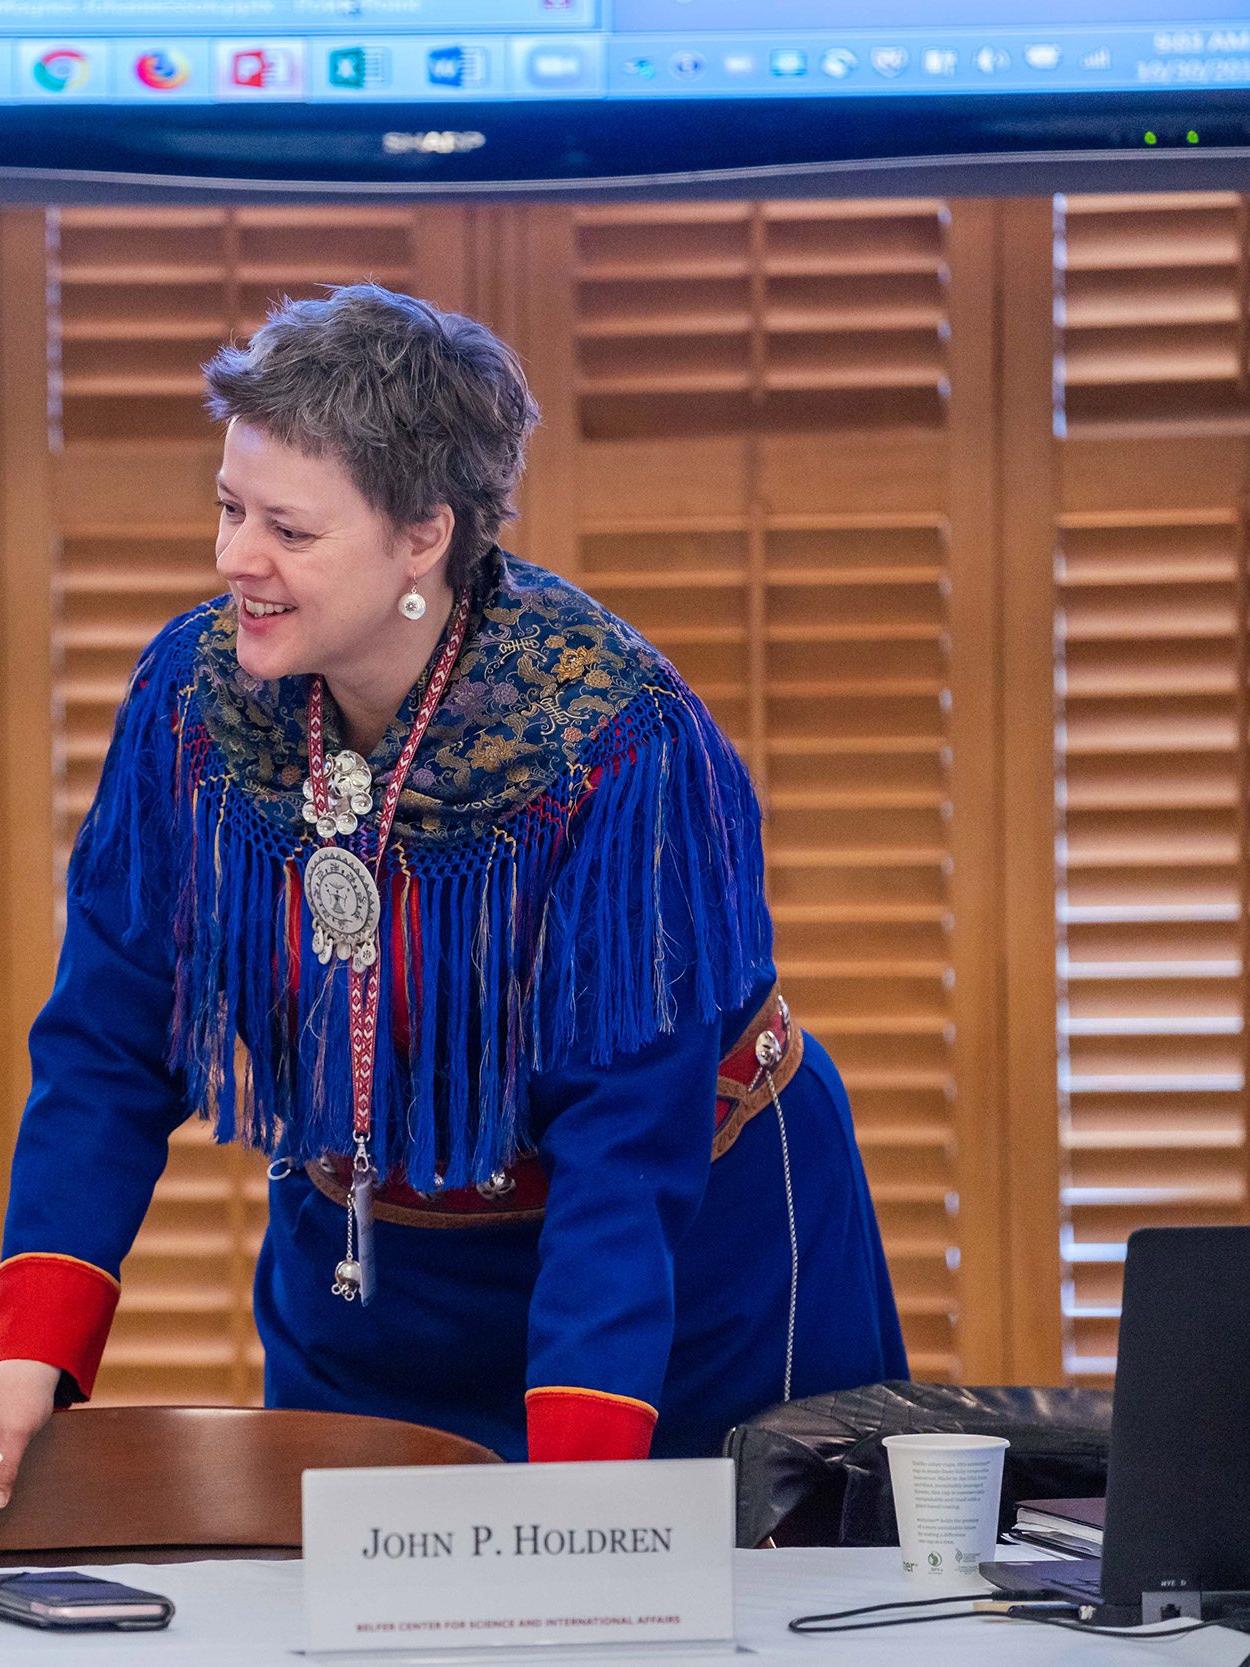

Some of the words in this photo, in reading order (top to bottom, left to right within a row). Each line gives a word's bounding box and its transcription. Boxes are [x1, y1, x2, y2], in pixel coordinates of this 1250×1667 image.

[473, 1526, 501, 1556] P.
[514, 1525, 672, 1555] HOLDREN
[399, 1621, 442, 1632] CENTER
[444, 1620, 466, 1631] FOR
[470, 1619, 515, 1630] SCIENCE
[518, 1618, 543, 1628] AND
[545, 1616, 633, 1627] INTERNATIONAL
[637, 1614, 682, 1625] AFFAIRS
